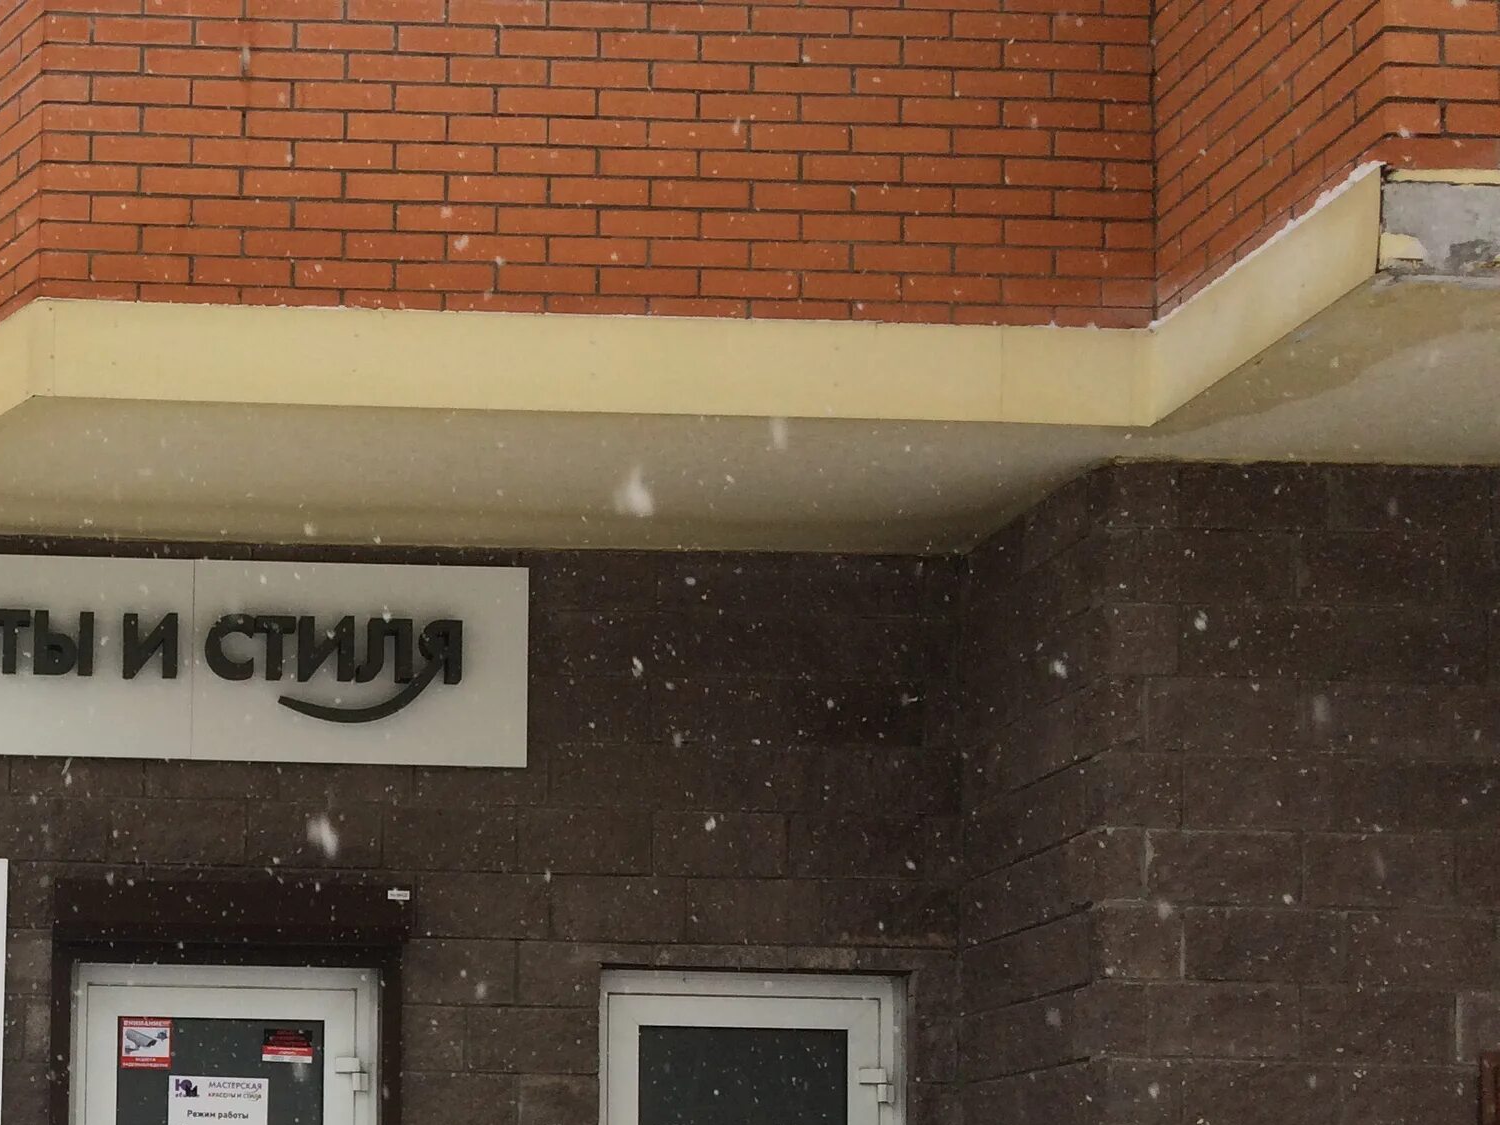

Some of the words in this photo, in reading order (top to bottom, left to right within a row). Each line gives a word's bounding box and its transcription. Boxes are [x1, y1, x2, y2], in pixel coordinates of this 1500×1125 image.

[123, 611, 179, 680] И
[204, 613, 464, 723] СТИЛЯ
[208, 1081, 262, 1093] МАСТЕРСКАЯ
[187, 1109, 216, 1119] Режим
[217, 1109, 249, 1120] работы
